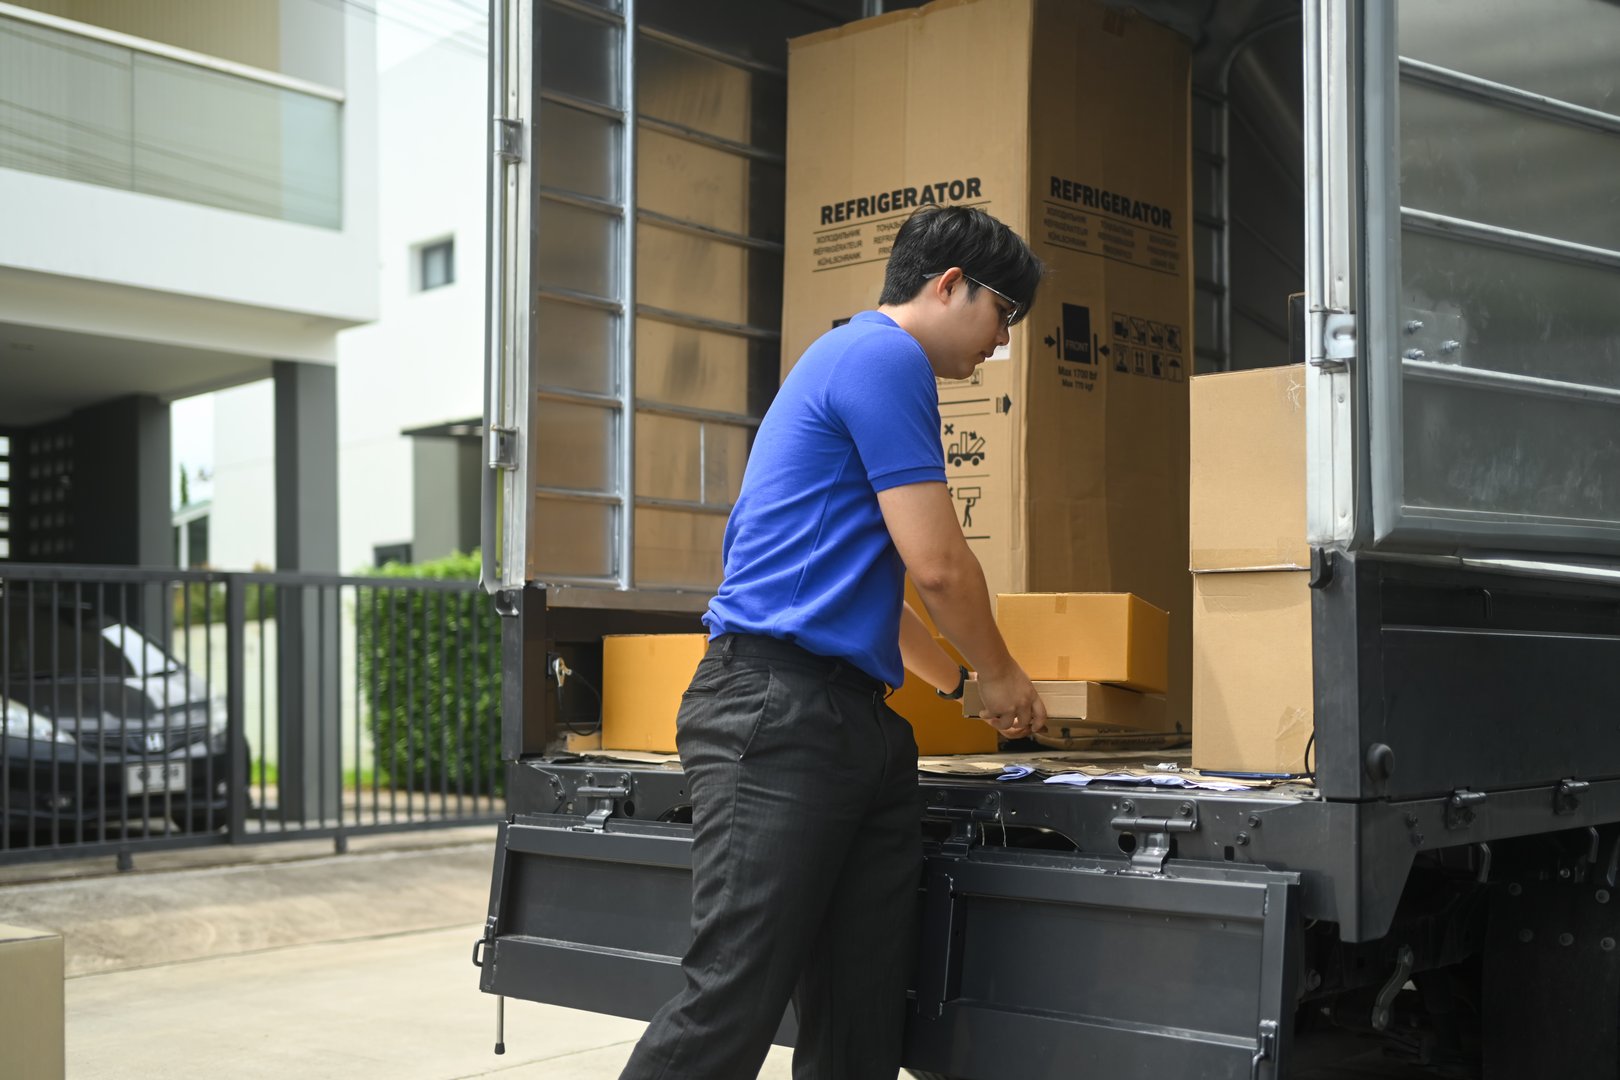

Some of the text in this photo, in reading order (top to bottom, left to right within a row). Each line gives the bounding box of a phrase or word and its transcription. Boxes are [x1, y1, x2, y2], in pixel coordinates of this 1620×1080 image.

[821, 177, 982, 225] REFRIGERATOR
[1050, 176, 1172, 229] REFRIGERATOR
[1065, 339, 1088, 353] FRONT
[1058, 366, 1072, 376] Max
